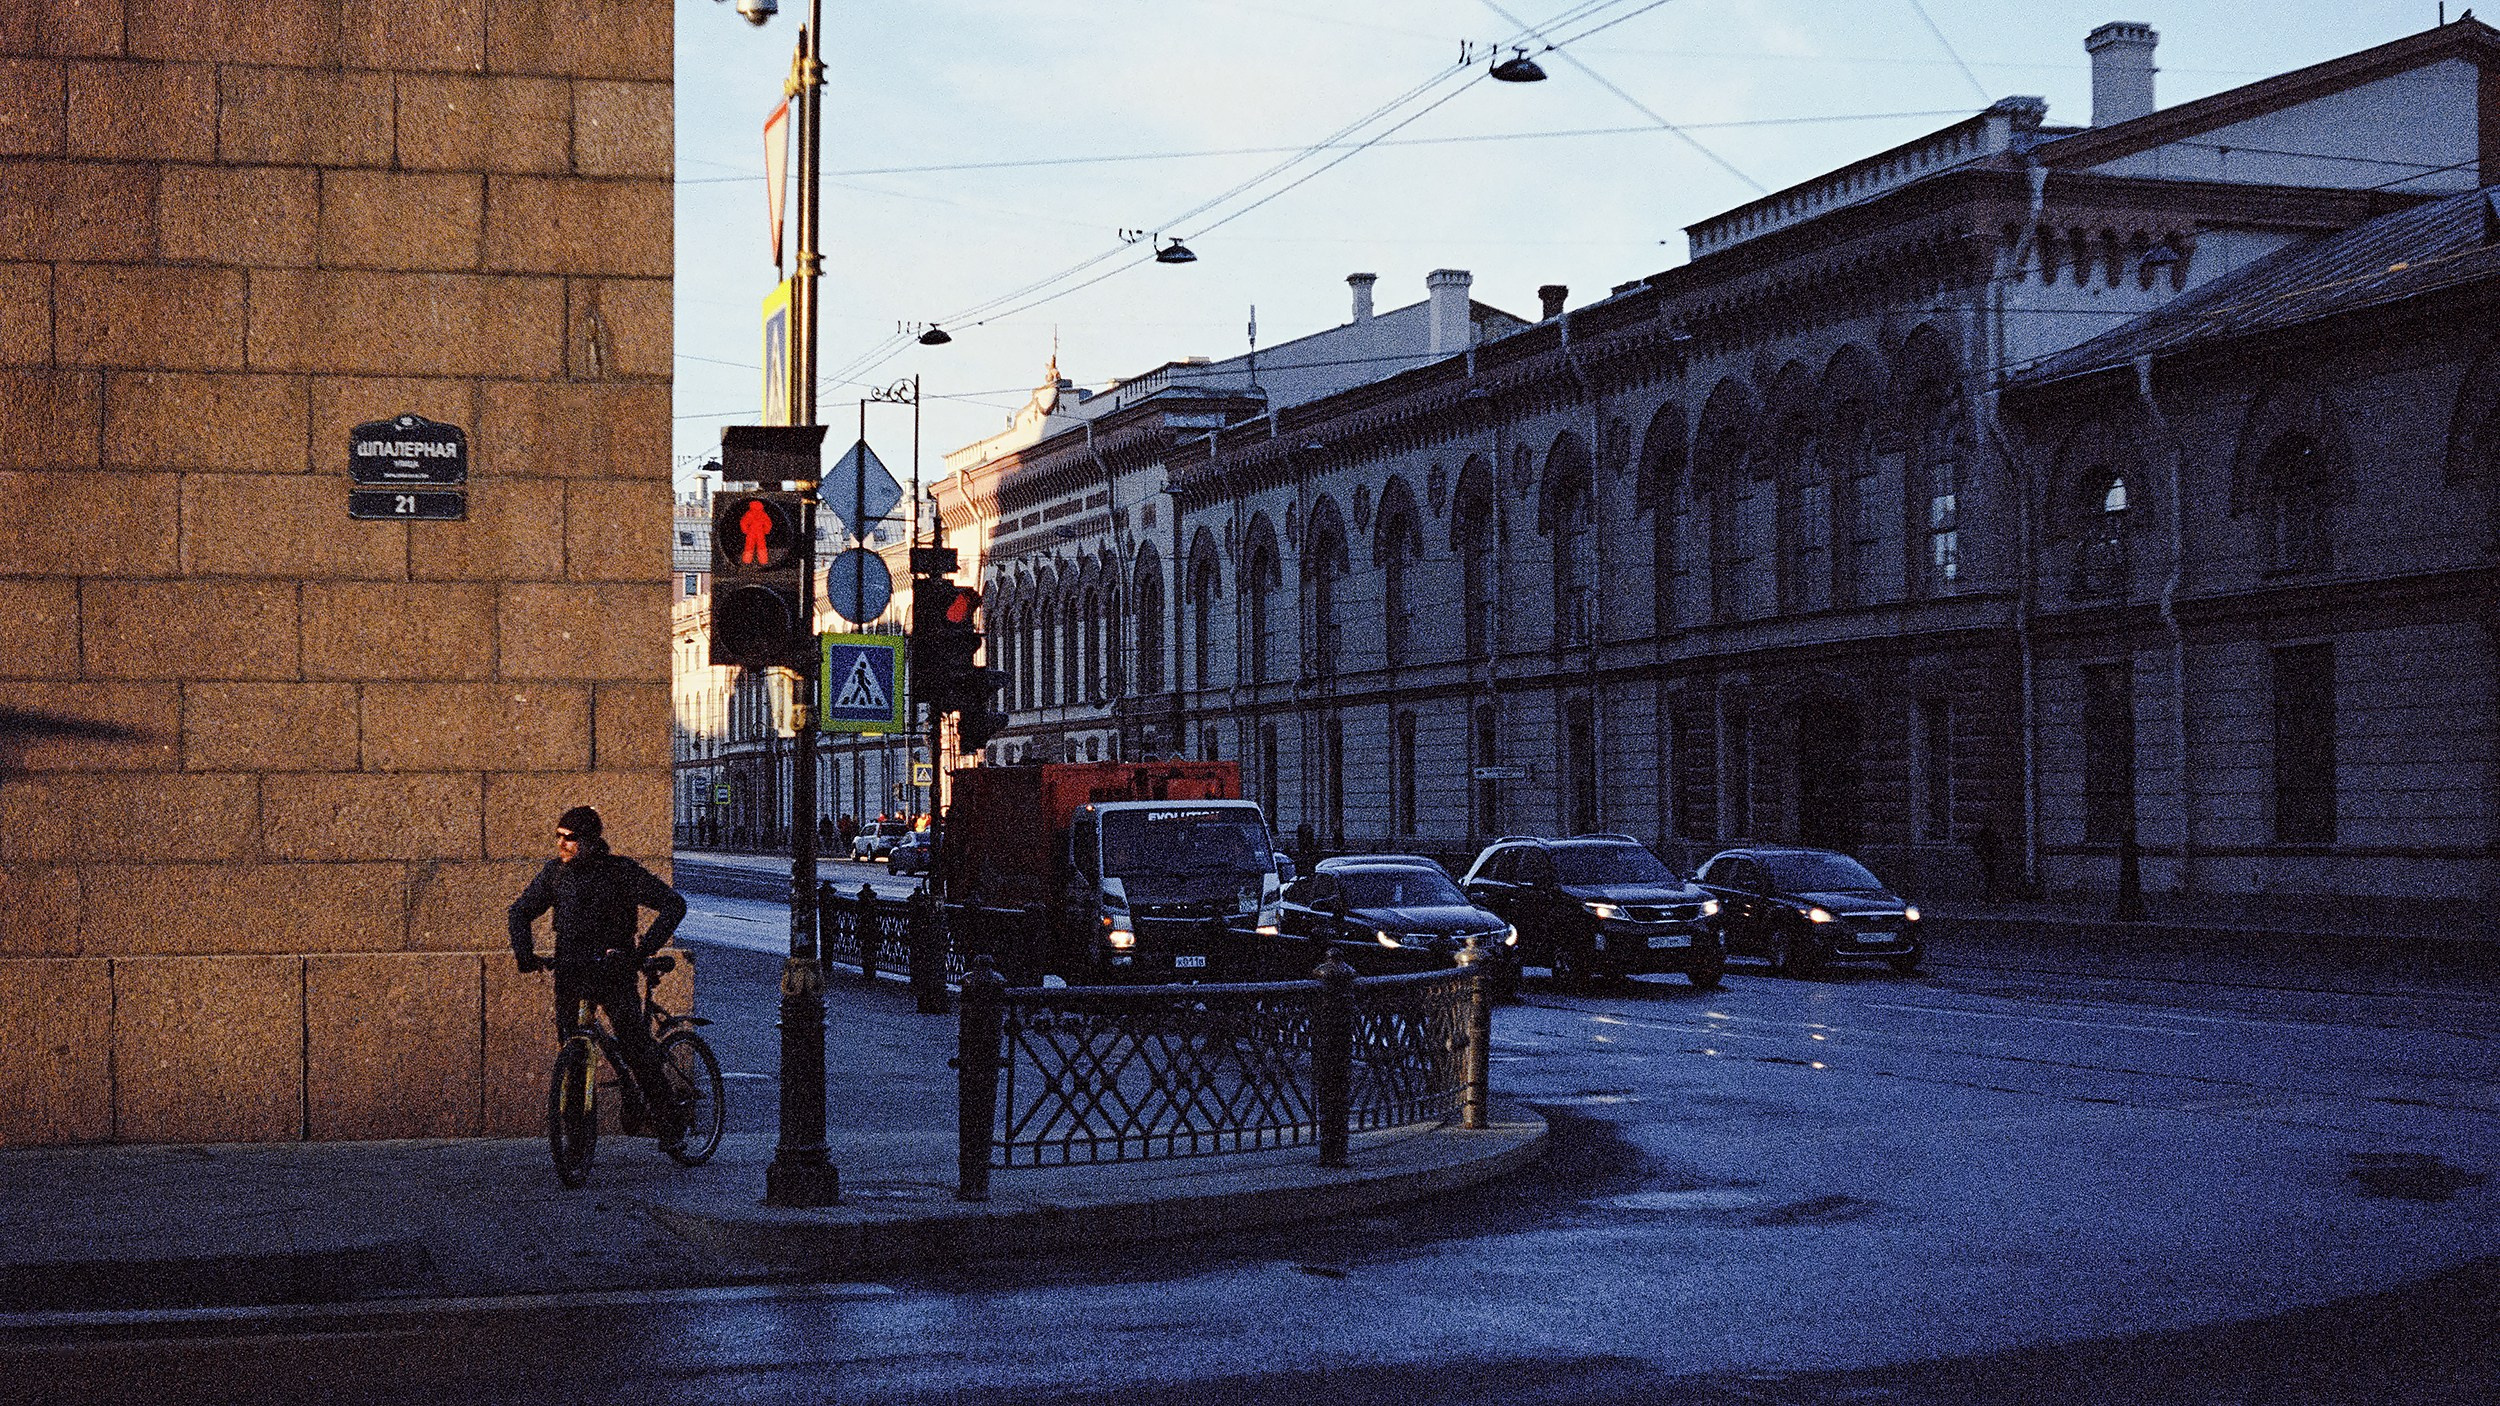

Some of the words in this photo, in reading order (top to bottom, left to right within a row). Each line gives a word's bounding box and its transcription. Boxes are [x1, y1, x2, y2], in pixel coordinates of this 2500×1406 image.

[357, 440, 457, 458] ШПАЛЕРНАЯ
[395, 494, 415, 513] 21
[1148, 811, 1220, 821] EVOLUT
